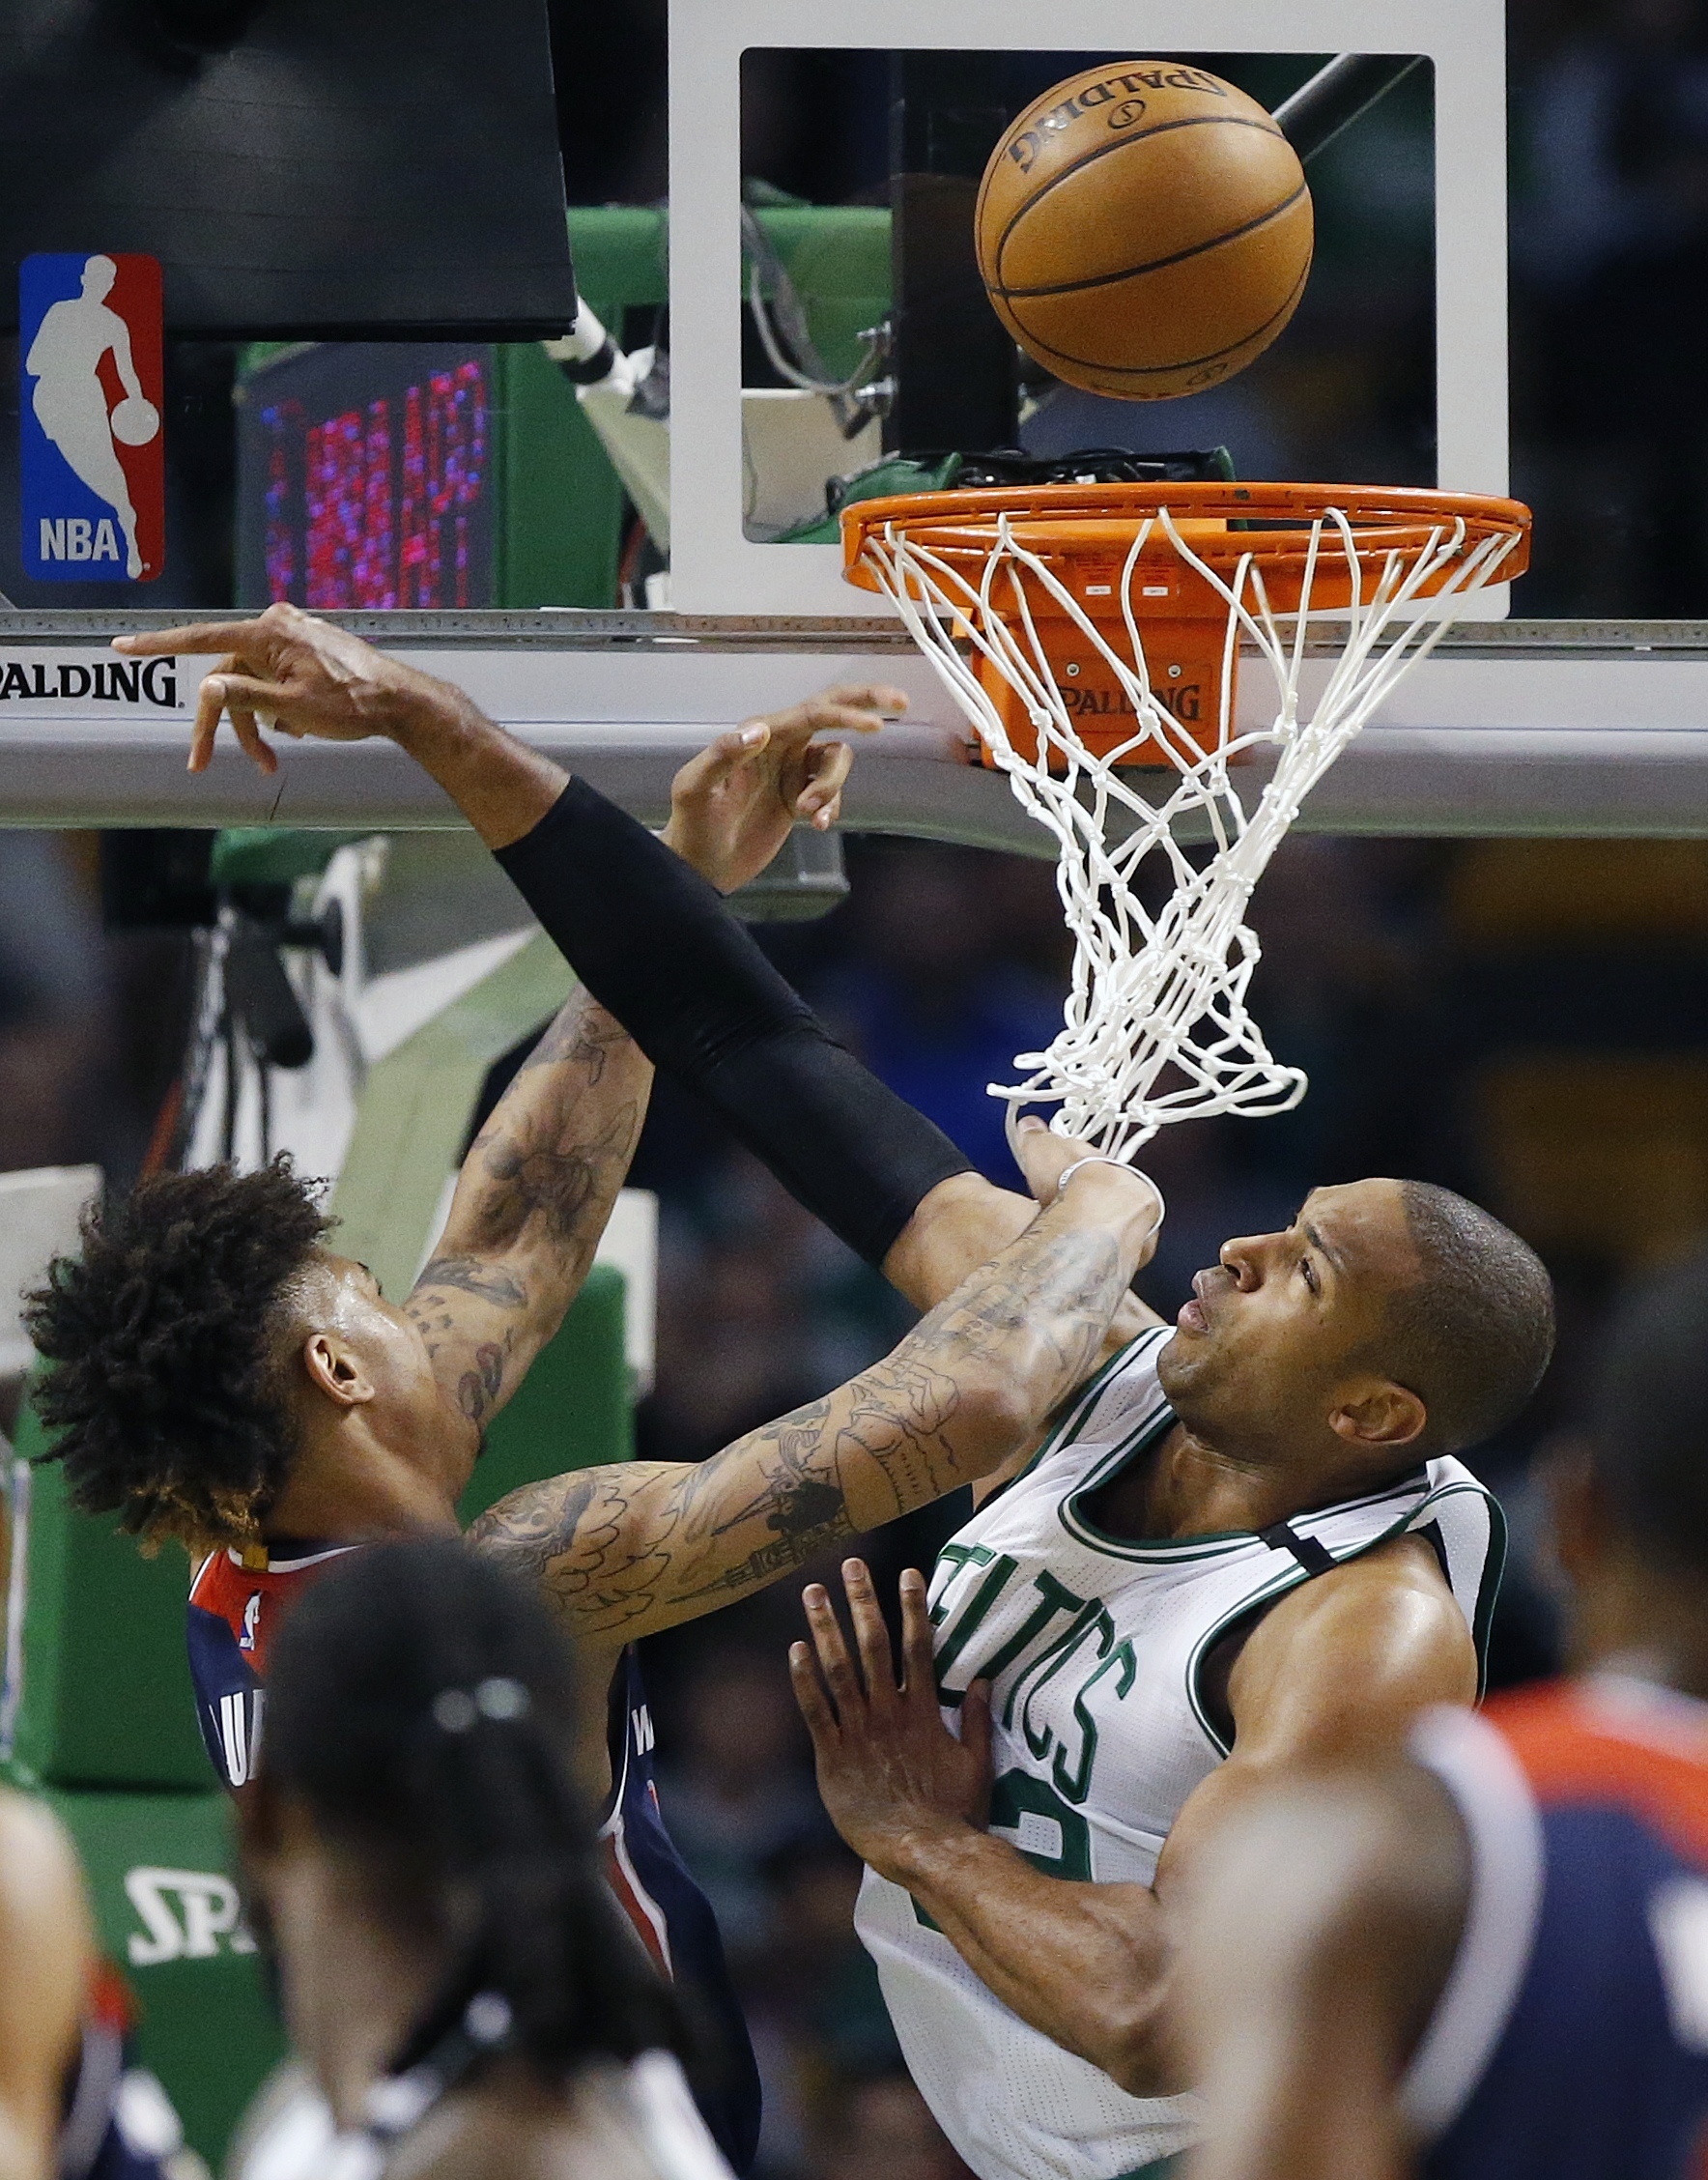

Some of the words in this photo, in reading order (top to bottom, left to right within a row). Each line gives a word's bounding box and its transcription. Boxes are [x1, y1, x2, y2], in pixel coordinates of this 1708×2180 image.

[40, 518, 120, 561] NBA
[0, 656, 177, 708] ALDING
[1045, 684, 1200, 721] PALDNG
